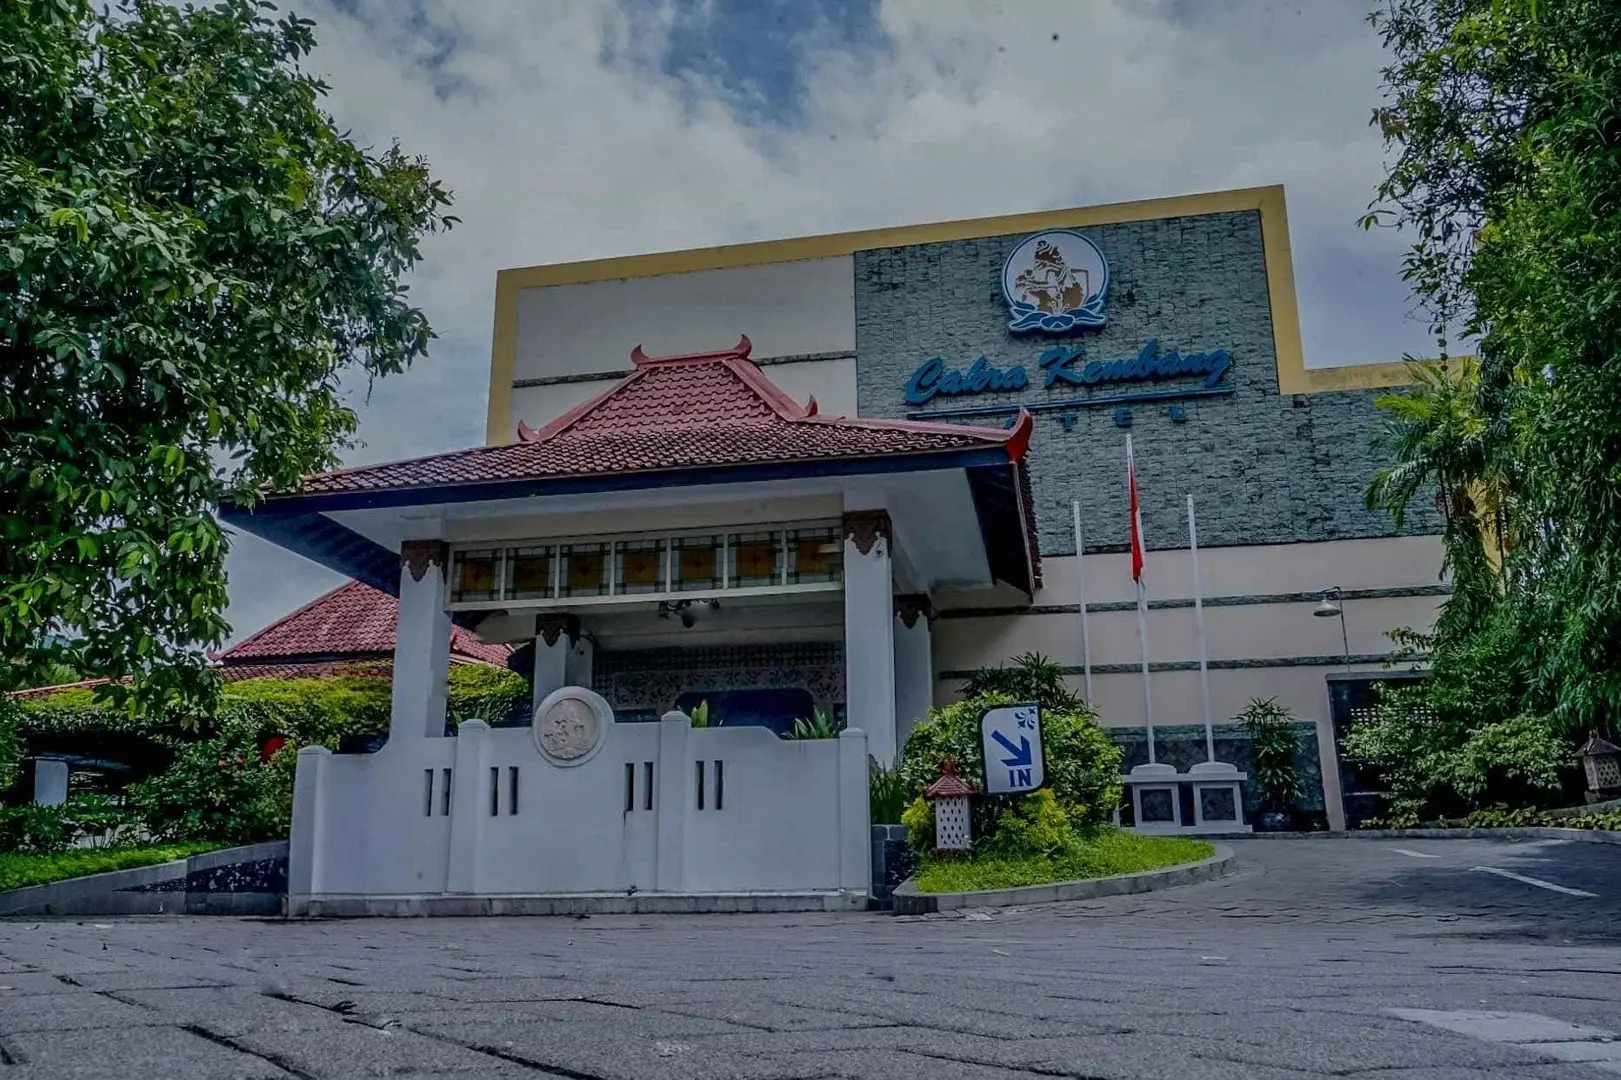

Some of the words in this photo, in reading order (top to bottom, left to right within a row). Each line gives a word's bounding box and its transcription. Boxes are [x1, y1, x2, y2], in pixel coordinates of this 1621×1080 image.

[905, 355, 1029, 405] Cakra
[1039, 339, 1233, 388] Kembang
[1009, 768, 1033, 788] IN
